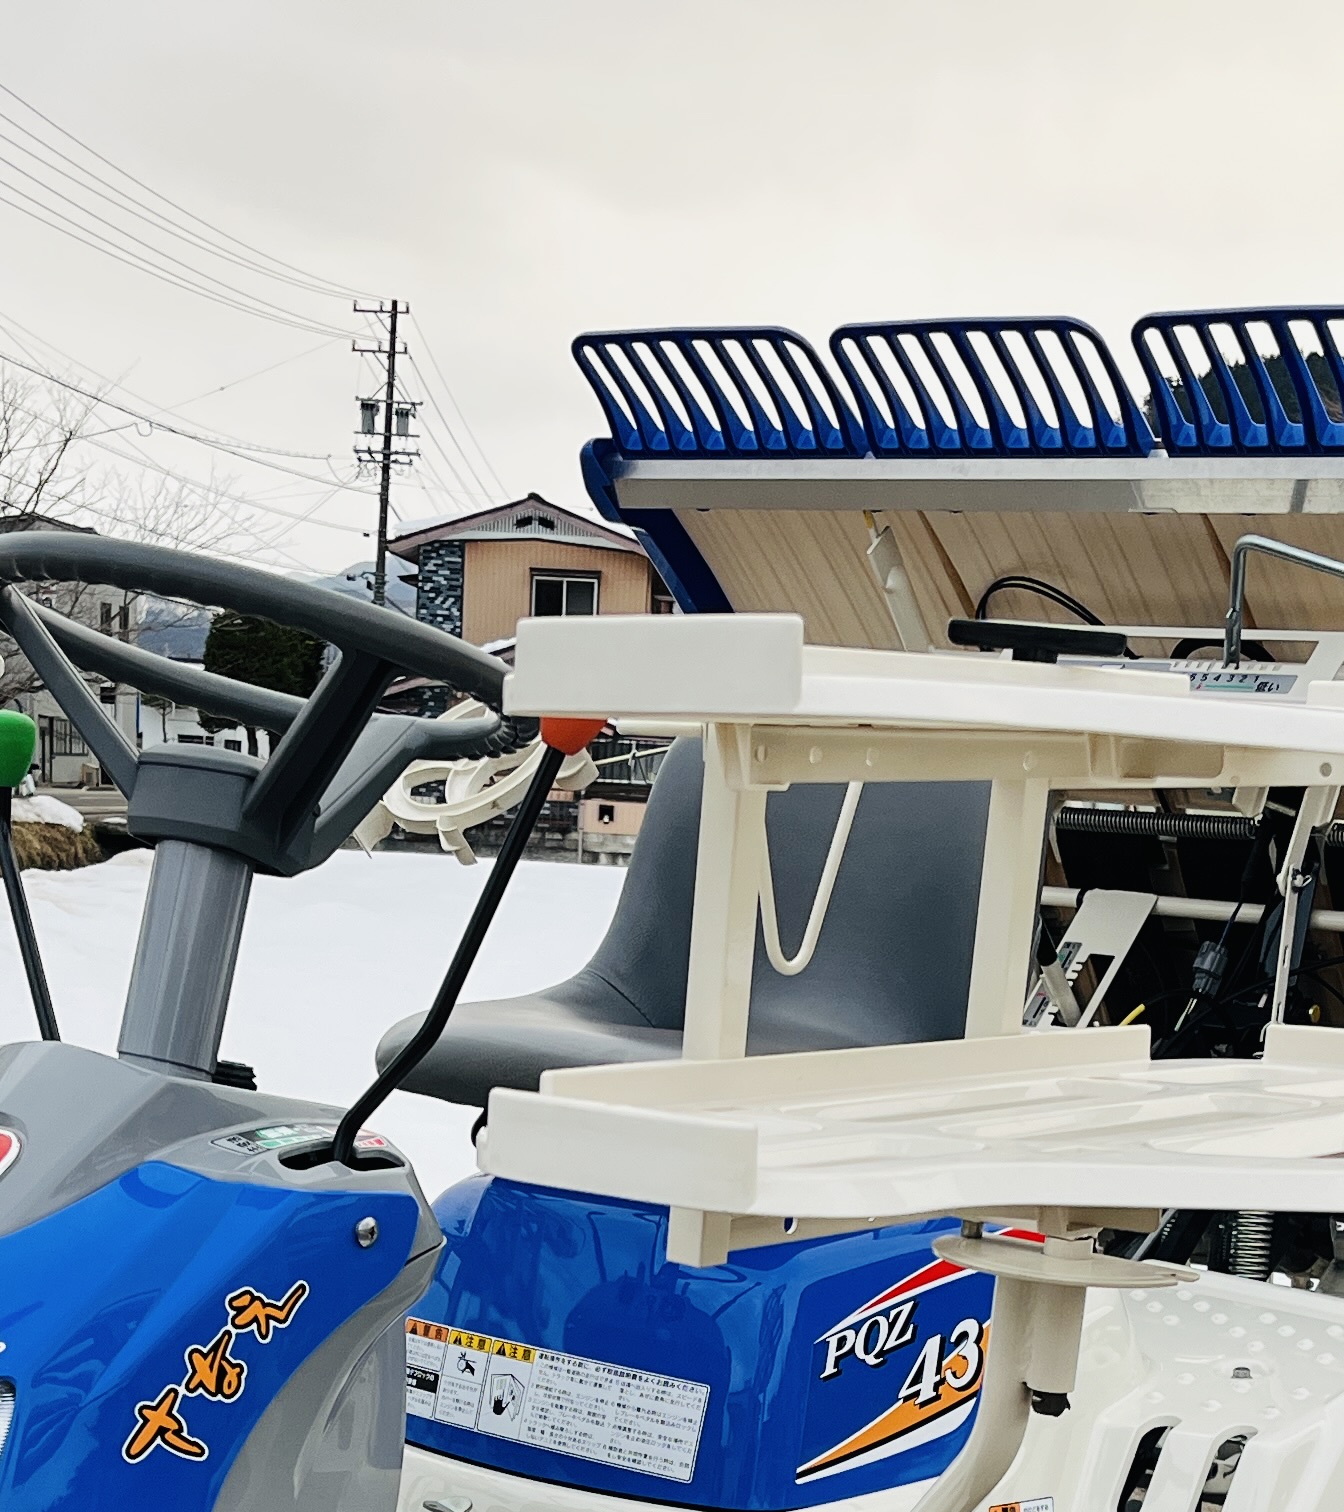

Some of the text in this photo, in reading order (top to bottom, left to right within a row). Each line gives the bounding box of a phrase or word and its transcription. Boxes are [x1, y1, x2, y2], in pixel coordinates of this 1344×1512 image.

[1213, 673, 1221, 681] 4
[1226, 674, 1235, 682] 3
[465, 1334, 487, 1350] 注意
[820, 1300, 917, 1381] PQZ
[509, 1345, 532, 1361] 注意
[898, 1318, 983, 1407] 43
